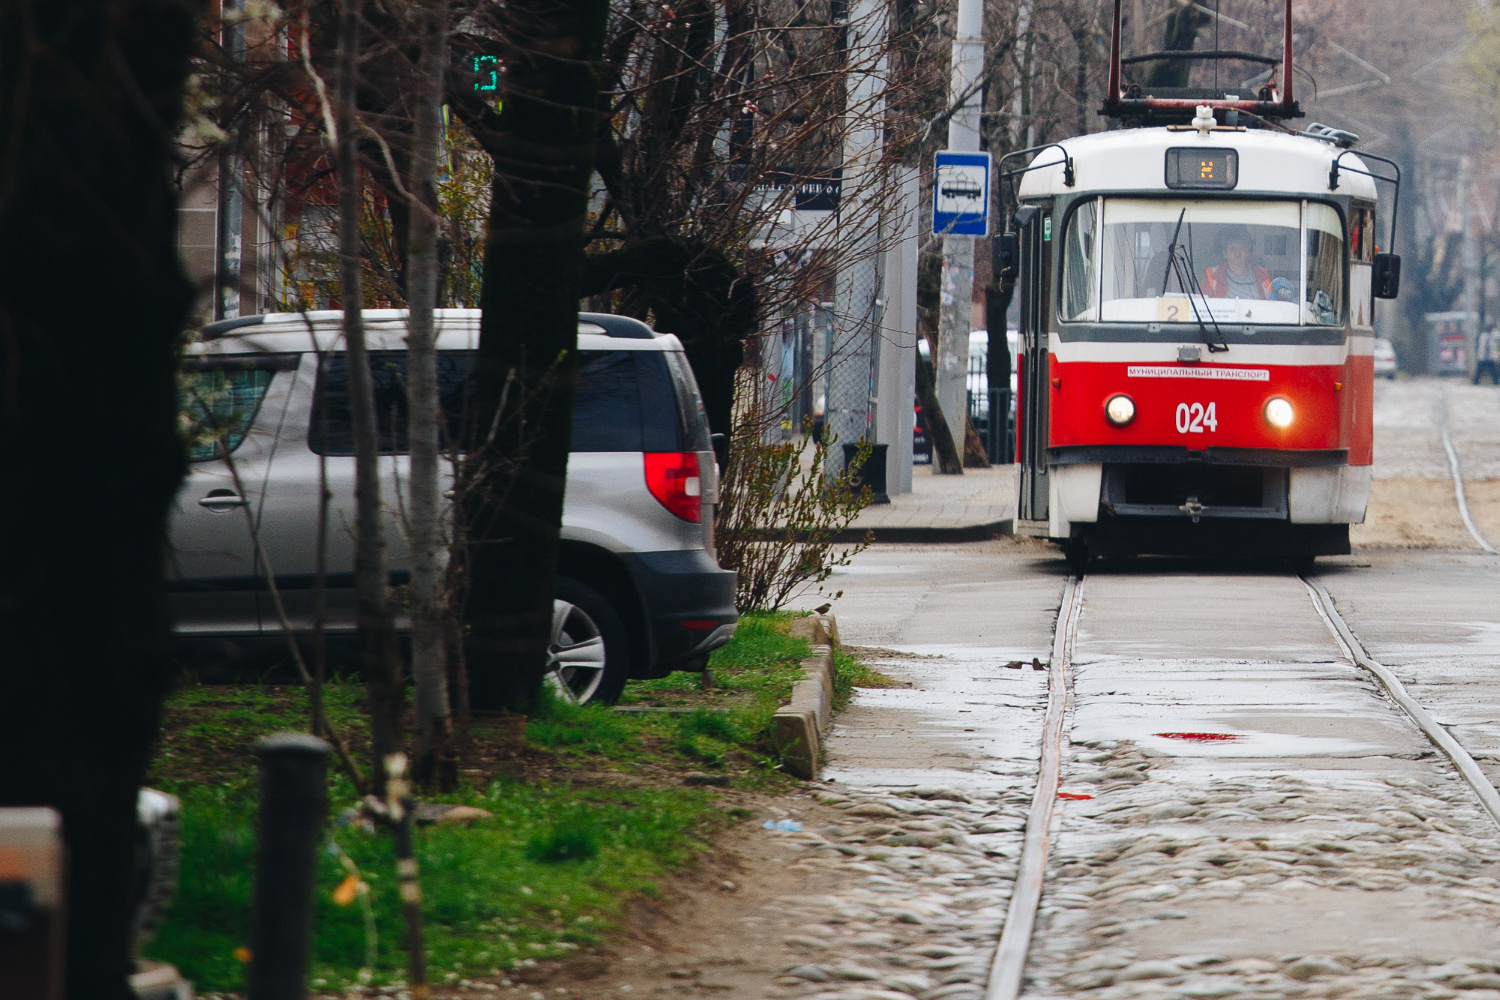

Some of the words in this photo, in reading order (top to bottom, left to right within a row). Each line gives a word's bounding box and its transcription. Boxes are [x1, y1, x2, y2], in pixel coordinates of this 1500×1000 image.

[1167, 305, 1179, 321] 2
[1129, 368, 1213, 378] МУНИЦИПАЛЬНЫЙ
[1215, 369, 1267, 379] ТРАНСПОРТ
[1175, 402, 1218, 434] 024
